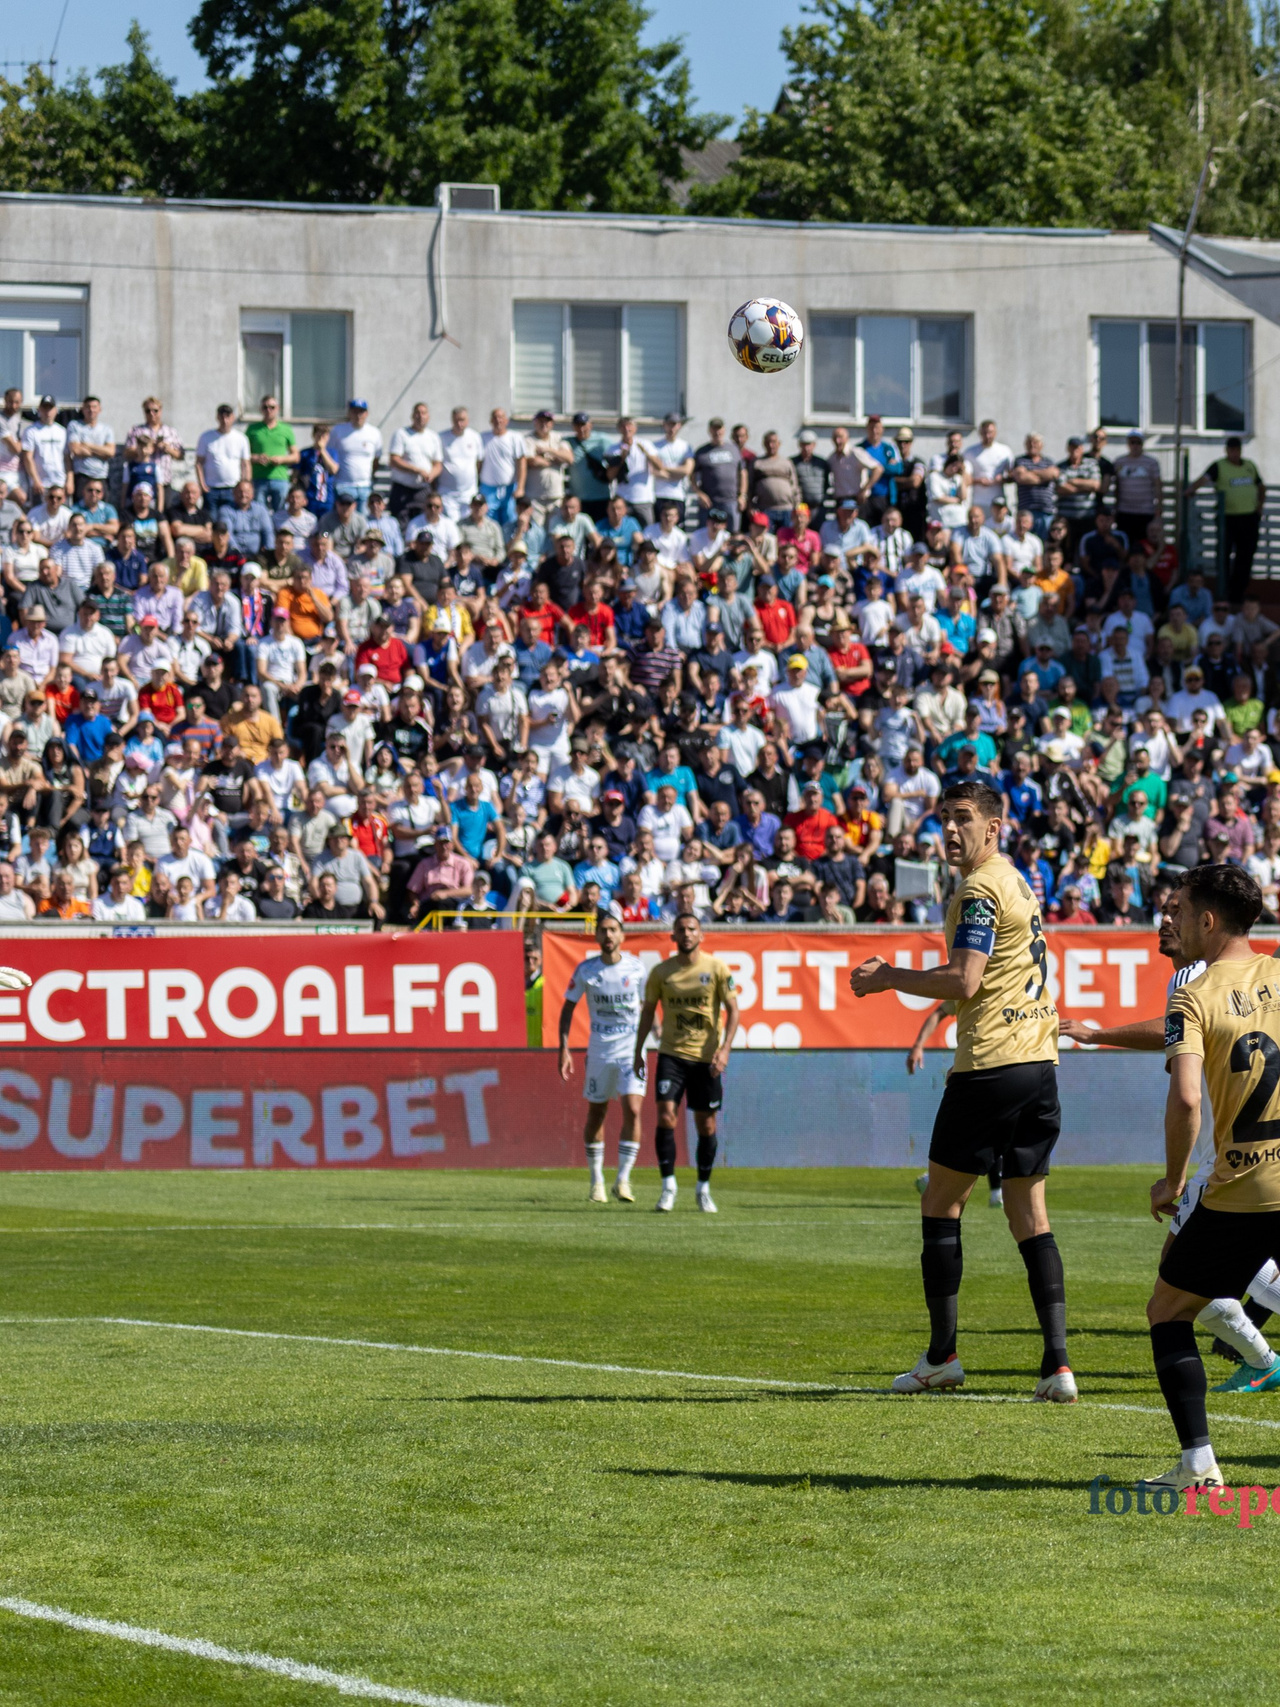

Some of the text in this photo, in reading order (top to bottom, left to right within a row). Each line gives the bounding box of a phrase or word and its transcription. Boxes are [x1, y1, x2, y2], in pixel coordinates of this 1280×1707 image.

[762, 350, 798, 363] SELECT
[964, 911, 991, 926] hilbor
[0, 1068, 499, 1166] SUPERBET
